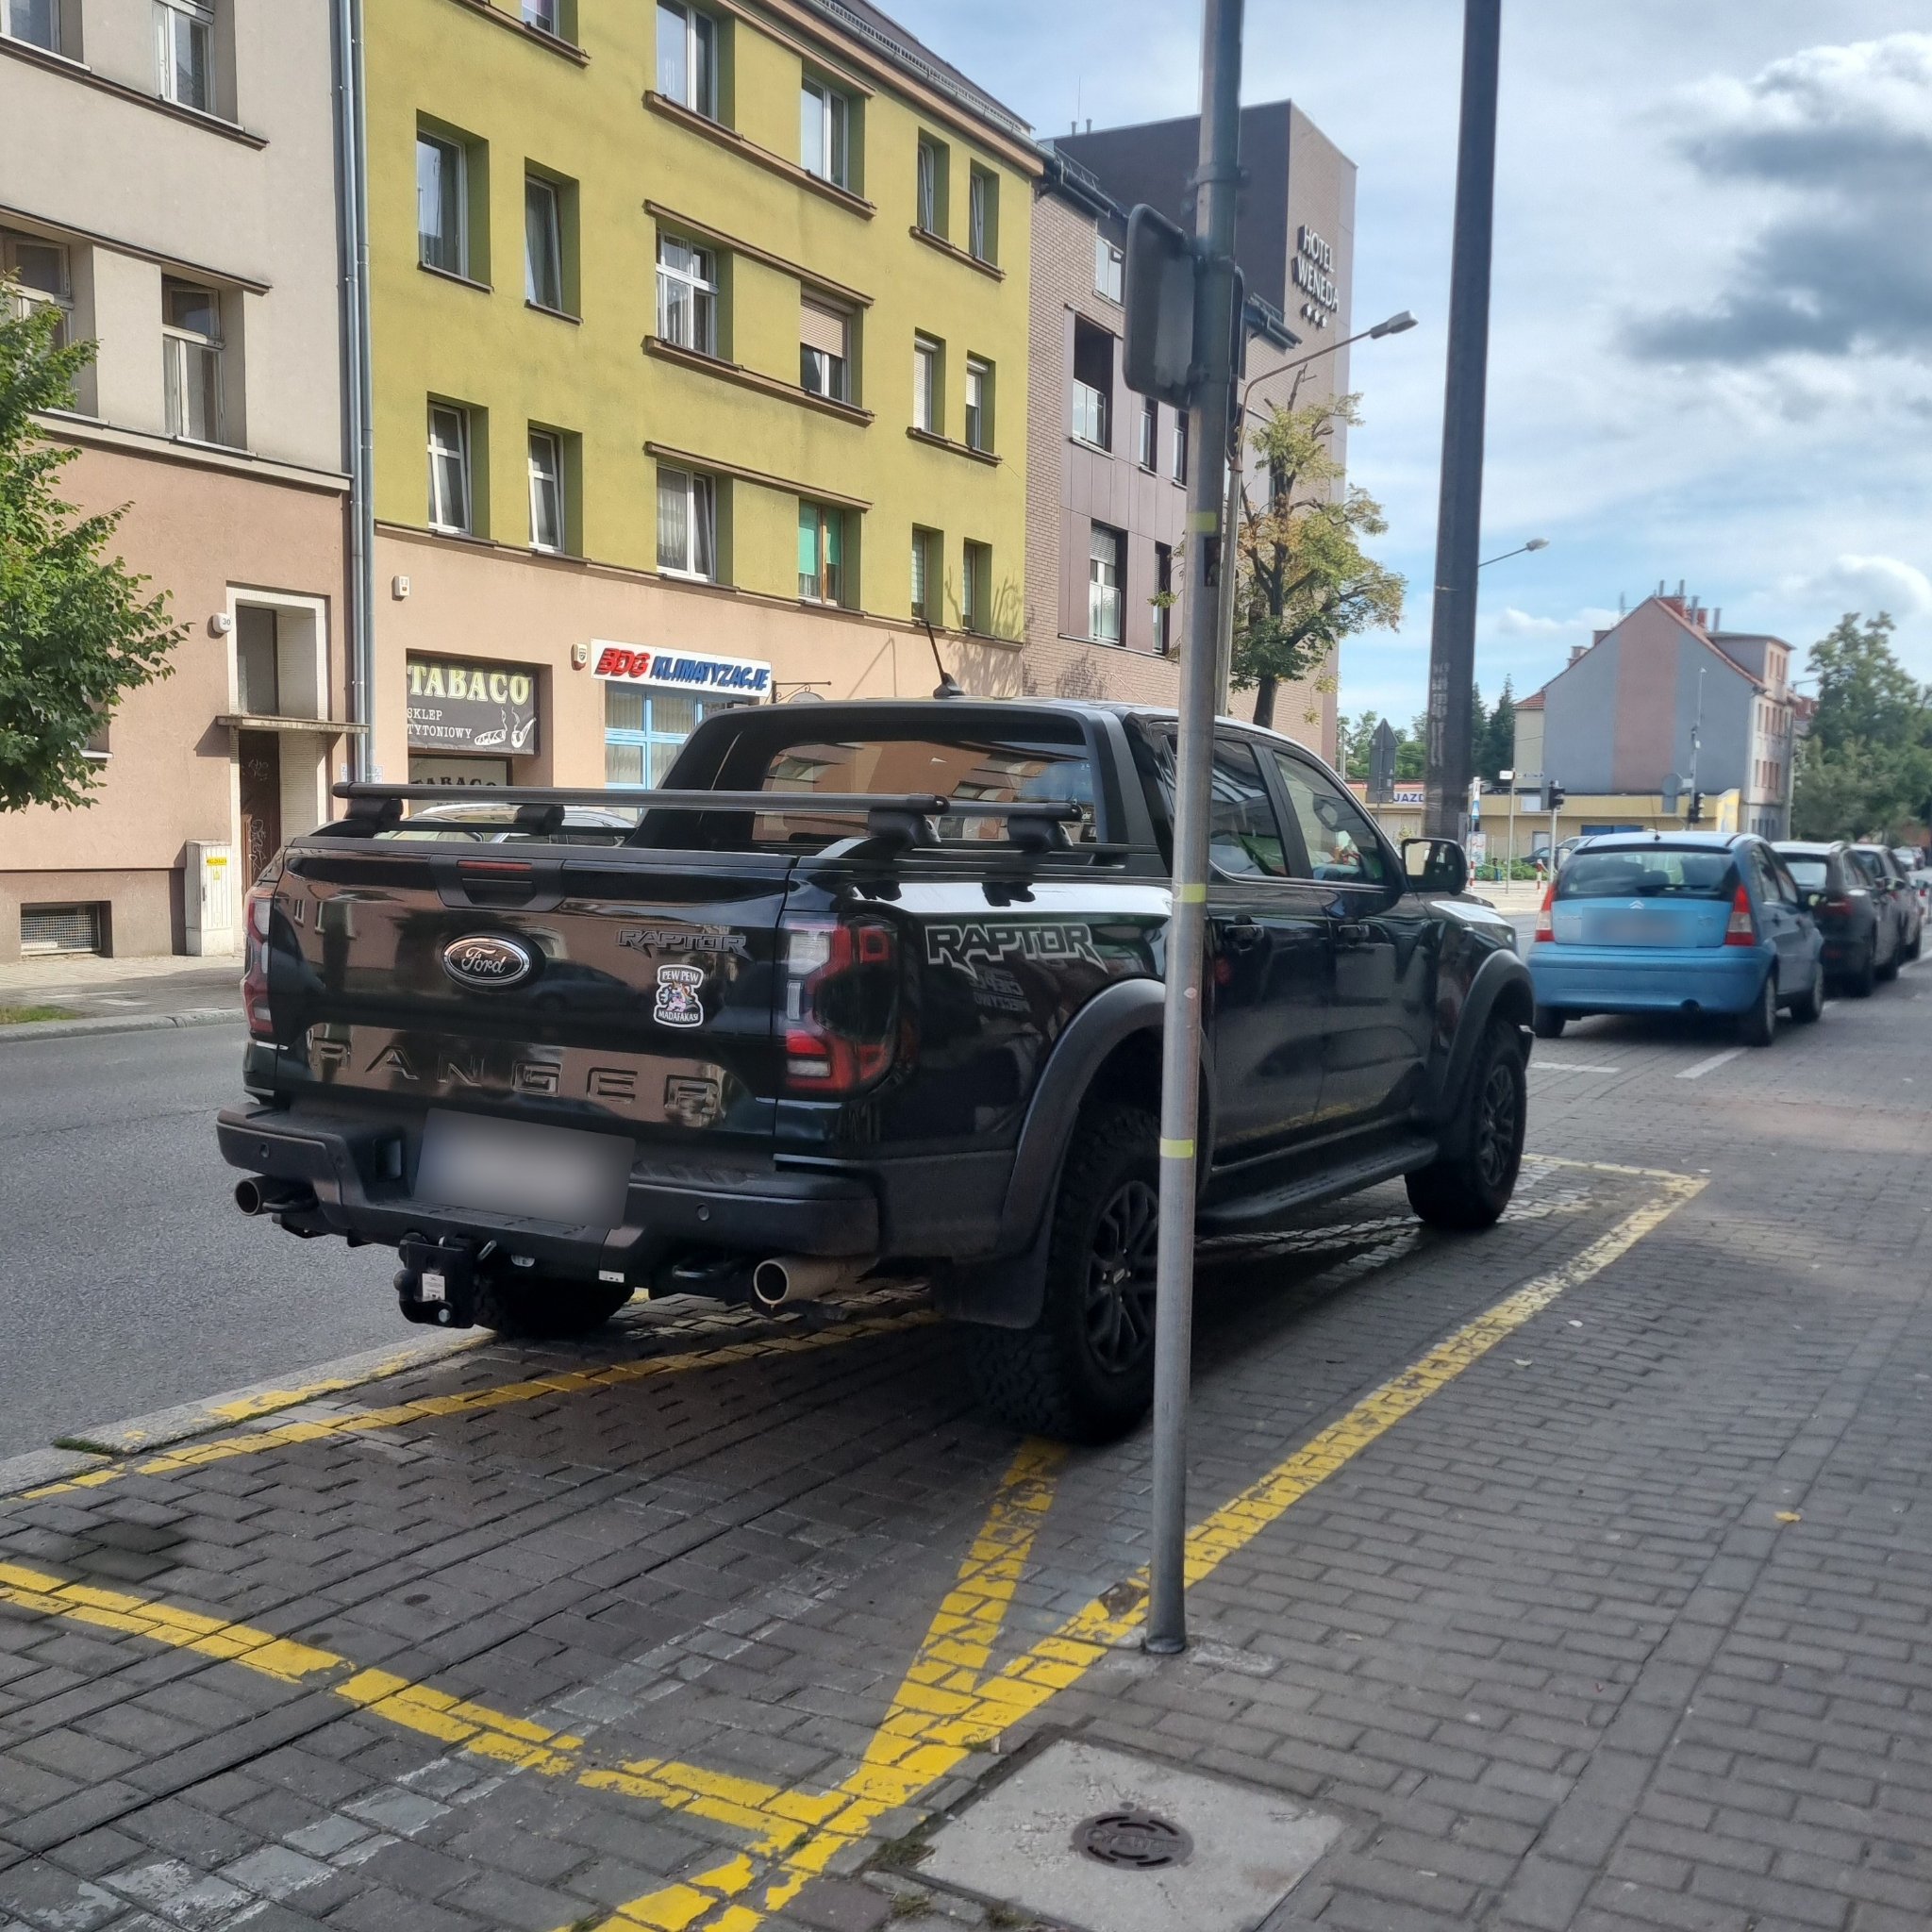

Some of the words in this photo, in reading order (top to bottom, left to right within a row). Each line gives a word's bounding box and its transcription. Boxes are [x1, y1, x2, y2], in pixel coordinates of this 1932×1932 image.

[1300, 225, 1335, 273] HOTEL
[1295, 255, 1339, 312] WENEDA
[407, 663, 530, 706] TABACO
[594, 647, 650, 678] BDG
[648, 656, 771, 691] KLIMATYZACJE
[407, 708, 443, 721] SKLEP
[407, 724, 473, 739] TYTONIOWY
[461, 946, 508, 974] Ford
[618, 928, 754, 961] RAPTOR
[924, 923, 1109, 979] RAPTOR
[662, 970, 679, 981] PEW
[680, 970, 699, 982] PEW
[308, 1037, 722, 1119] RANGER
